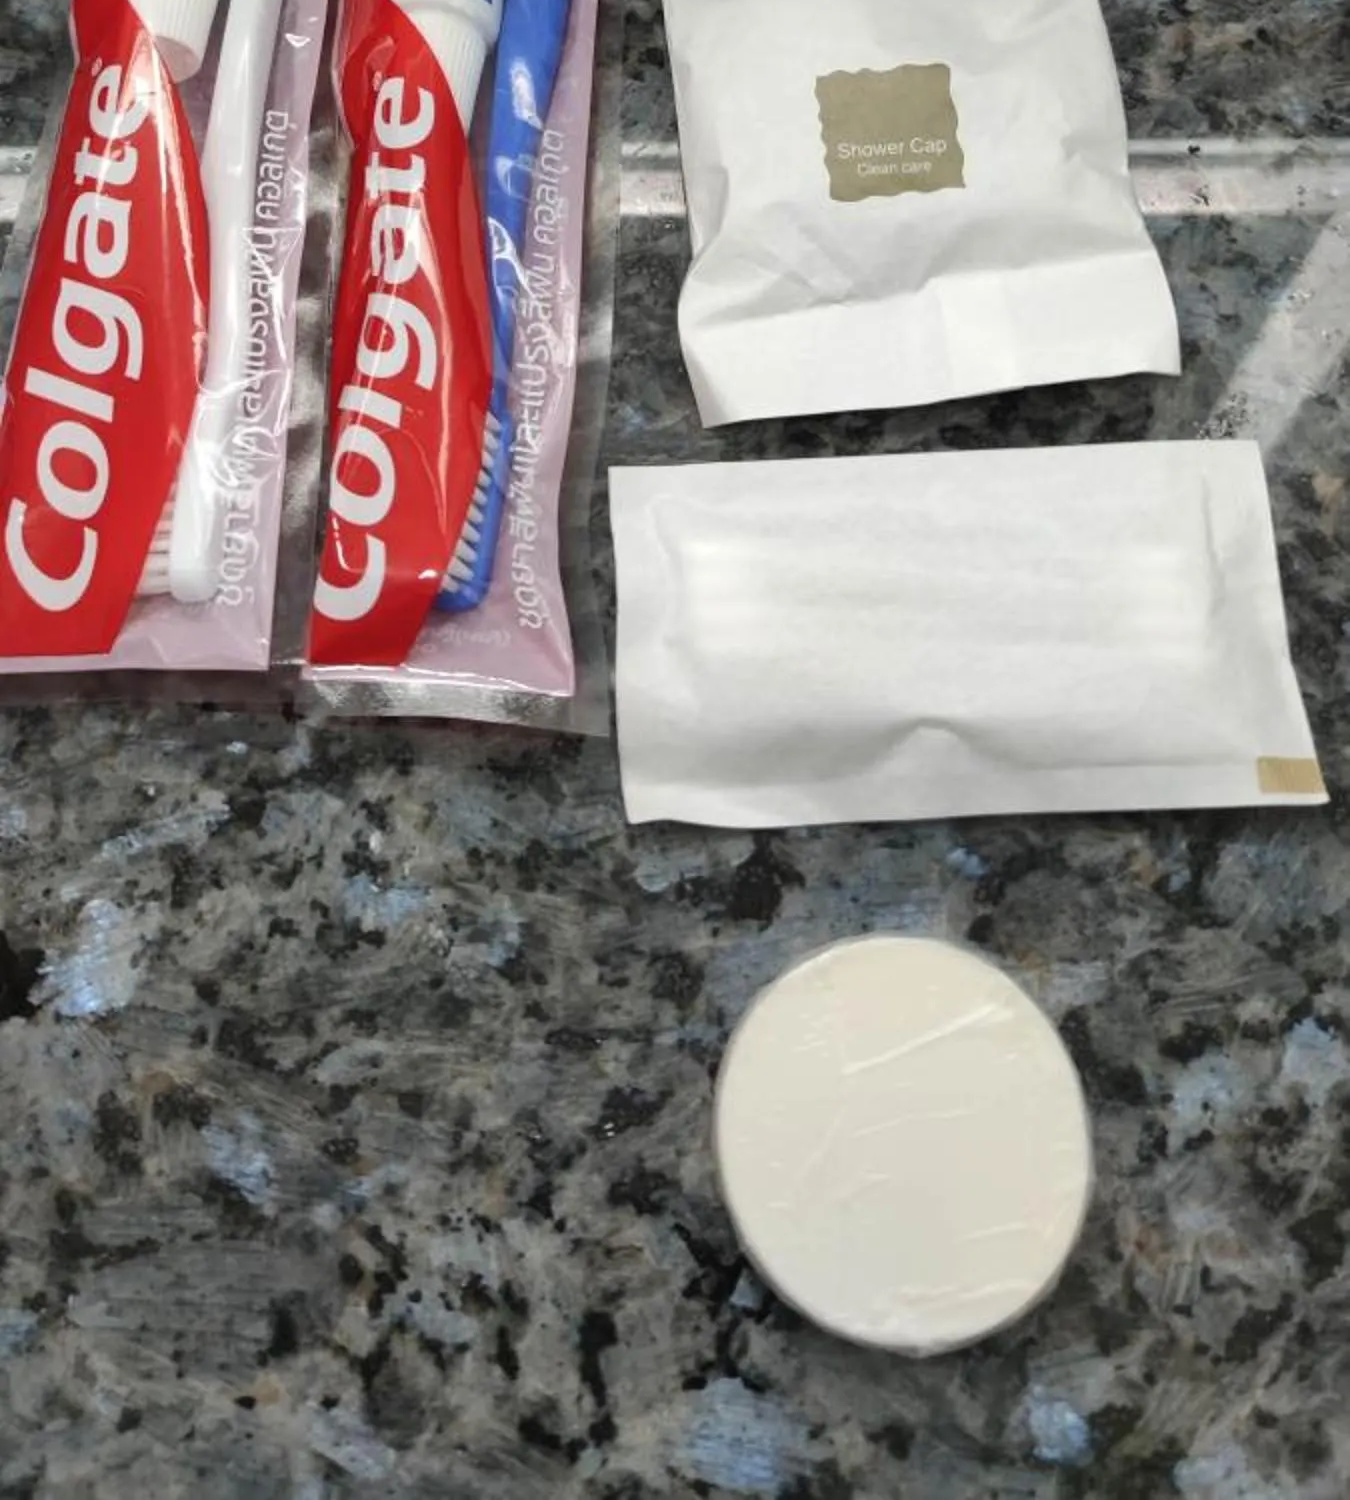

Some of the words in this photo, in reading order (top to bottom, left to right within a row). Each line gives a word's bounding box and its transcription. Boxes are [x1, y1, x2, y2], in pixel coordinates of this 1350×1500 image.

[837, 140, 903, 160] Shower
[909, 136, 947, 156] Cap
[857, 162, 898, 177] Clean
[901, 160, 932, 175] care
[5, 62, 149, 611] Colgate
[313, 74, 438, 621] Colgate
